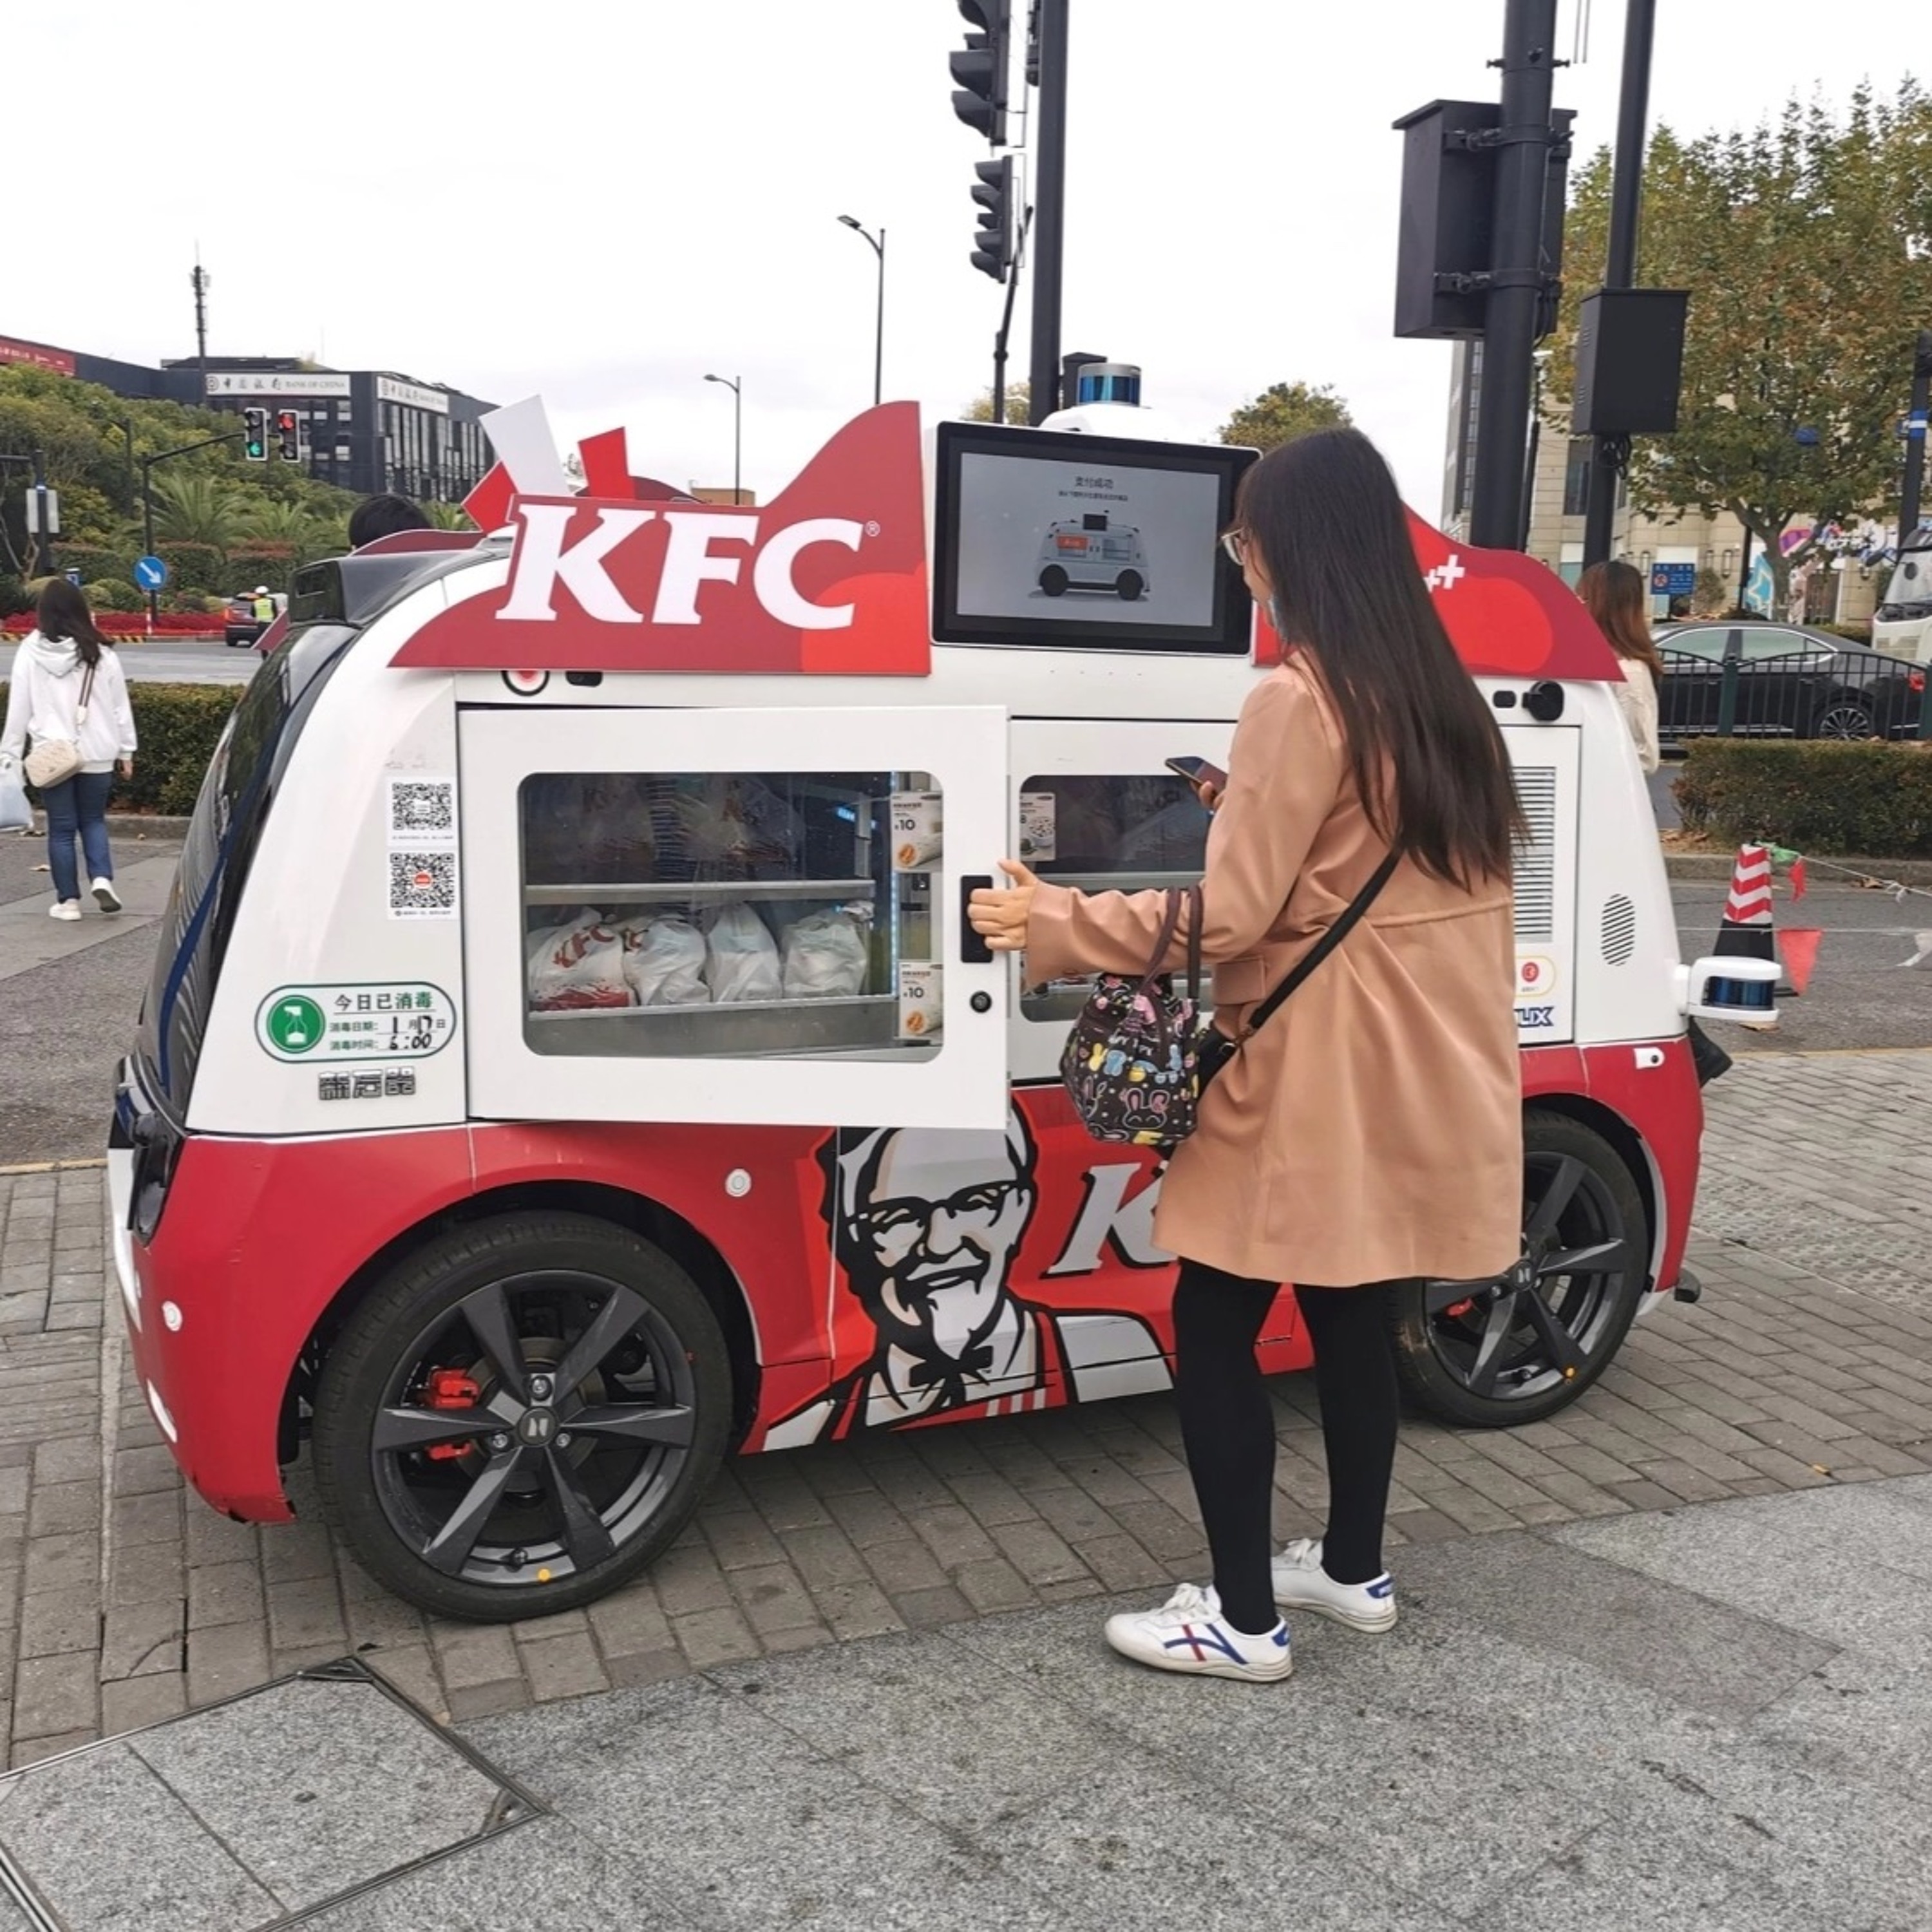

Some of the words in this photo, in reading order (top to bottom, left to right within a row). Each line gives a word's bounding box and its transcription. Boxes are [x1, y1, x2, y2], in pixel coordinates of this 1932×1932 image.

[495, 504, 864, 630] KFC
[334, 991, 433, 1011] 今日已消毒
